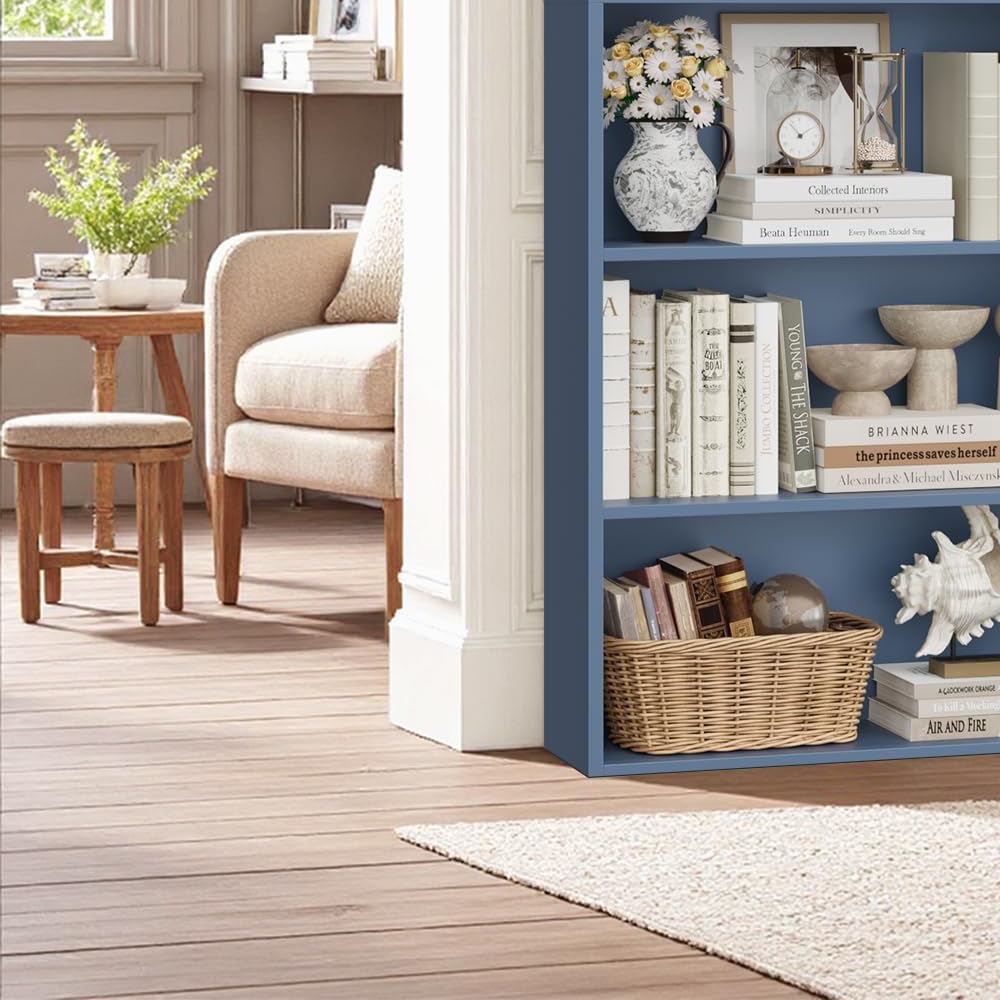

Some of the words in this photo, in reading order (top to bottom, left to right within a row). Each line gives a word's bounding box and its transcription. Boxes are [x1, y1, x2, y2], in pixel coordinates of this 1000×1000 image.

[808, 185, 849, 196] Collected
[852, 184, 889, 195] Interiors
[814, 207, 880, 215] SIMPLICITY
[760, 228, 785, 238] Beata
[789, 227, 829, 238] Heuman
[848, 228, 866, 236] Every
[868, 228, 887, 236] Room
[912, 228, 926, 236] Sing
[602, 297, 617, 316] A
[788, 323, 803, 370] YOUNG
[790, 382, 806, 410] THE
[793, 412, 810, 455] SHACK
[868, 426, 928, 437] BRIANNA
[935, 424, 974, 435] WIEST
[856, 450, 874, 462] the
[876, 449, 924, 464] princess
[925, 450, 956, 461] saves
[958, 446, 997, 460] herself
[838, 475, 891, 487] Alexandra
[892, 475, 901, 484] &
[904, 470, 945, 485] Michael
[943, 686, 974, 695] CLOCKWORK
[975, 685, 996, 693] ORANGE
[944, 702, 959, 712] Kill
[927, 720, 943, 734] AIR
[945, 720, 965, 733] AND
[968, 718, 987, 732] FIRE
